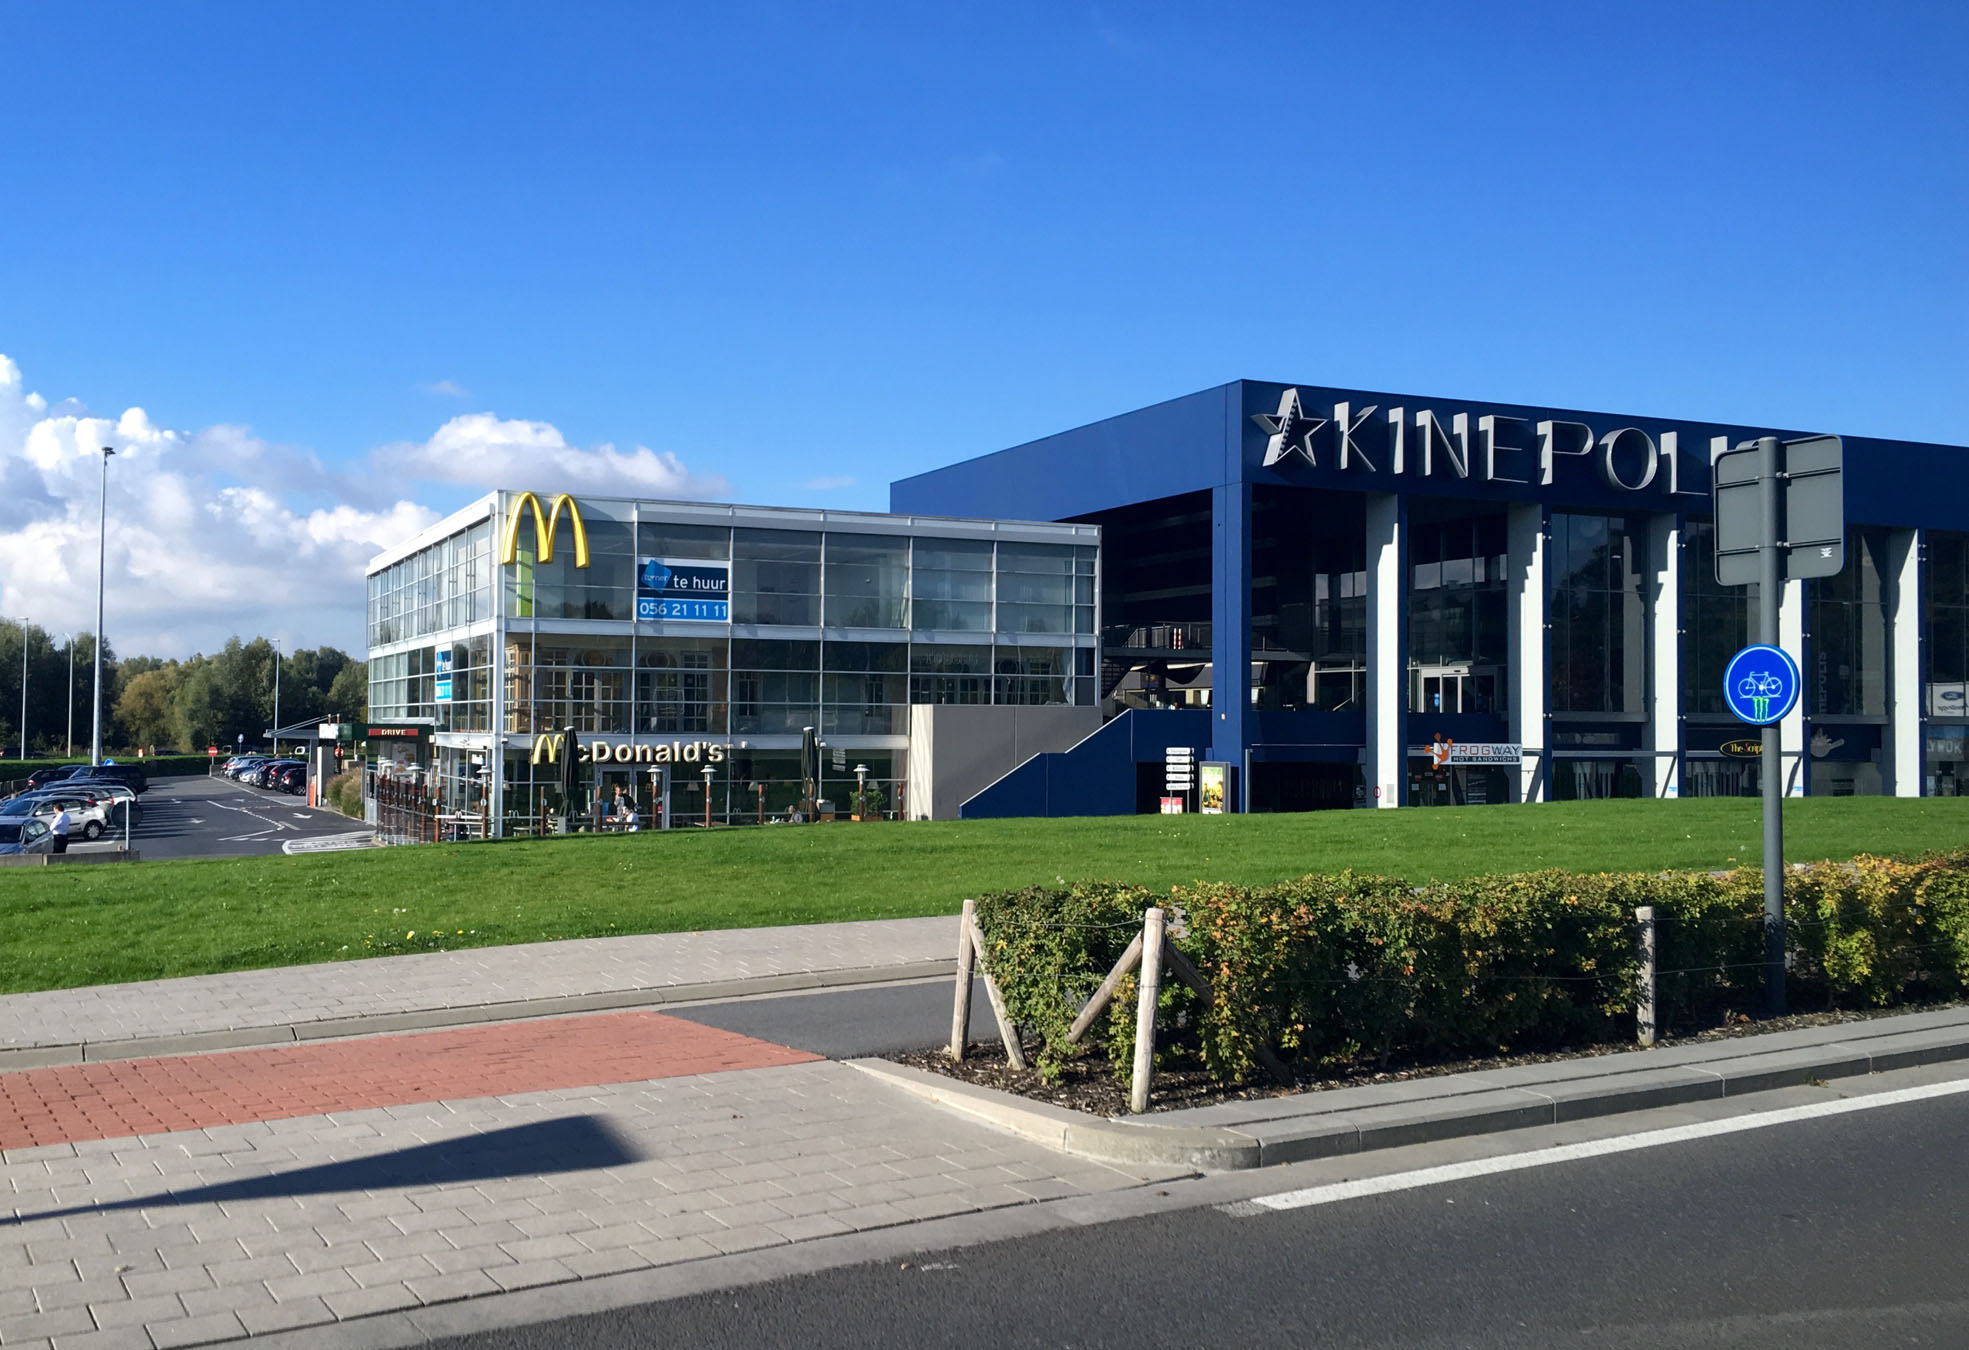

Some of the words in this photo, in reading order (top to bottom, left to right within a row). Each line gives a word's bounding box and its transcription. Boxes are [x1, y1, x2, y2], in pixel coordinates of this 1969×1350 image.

[673, 575, 688, 588] te
[693, 576, 726, 590] huur
[640, 602, 667, 615] 056
[672, 603, 687, 617] 21
[694, 604, 707, 617] 11
[714, 604, 727, 617] 11
[381, 728, 407, 736] DRIVE
[1450, 745, 1521, 756] FROGWAY
